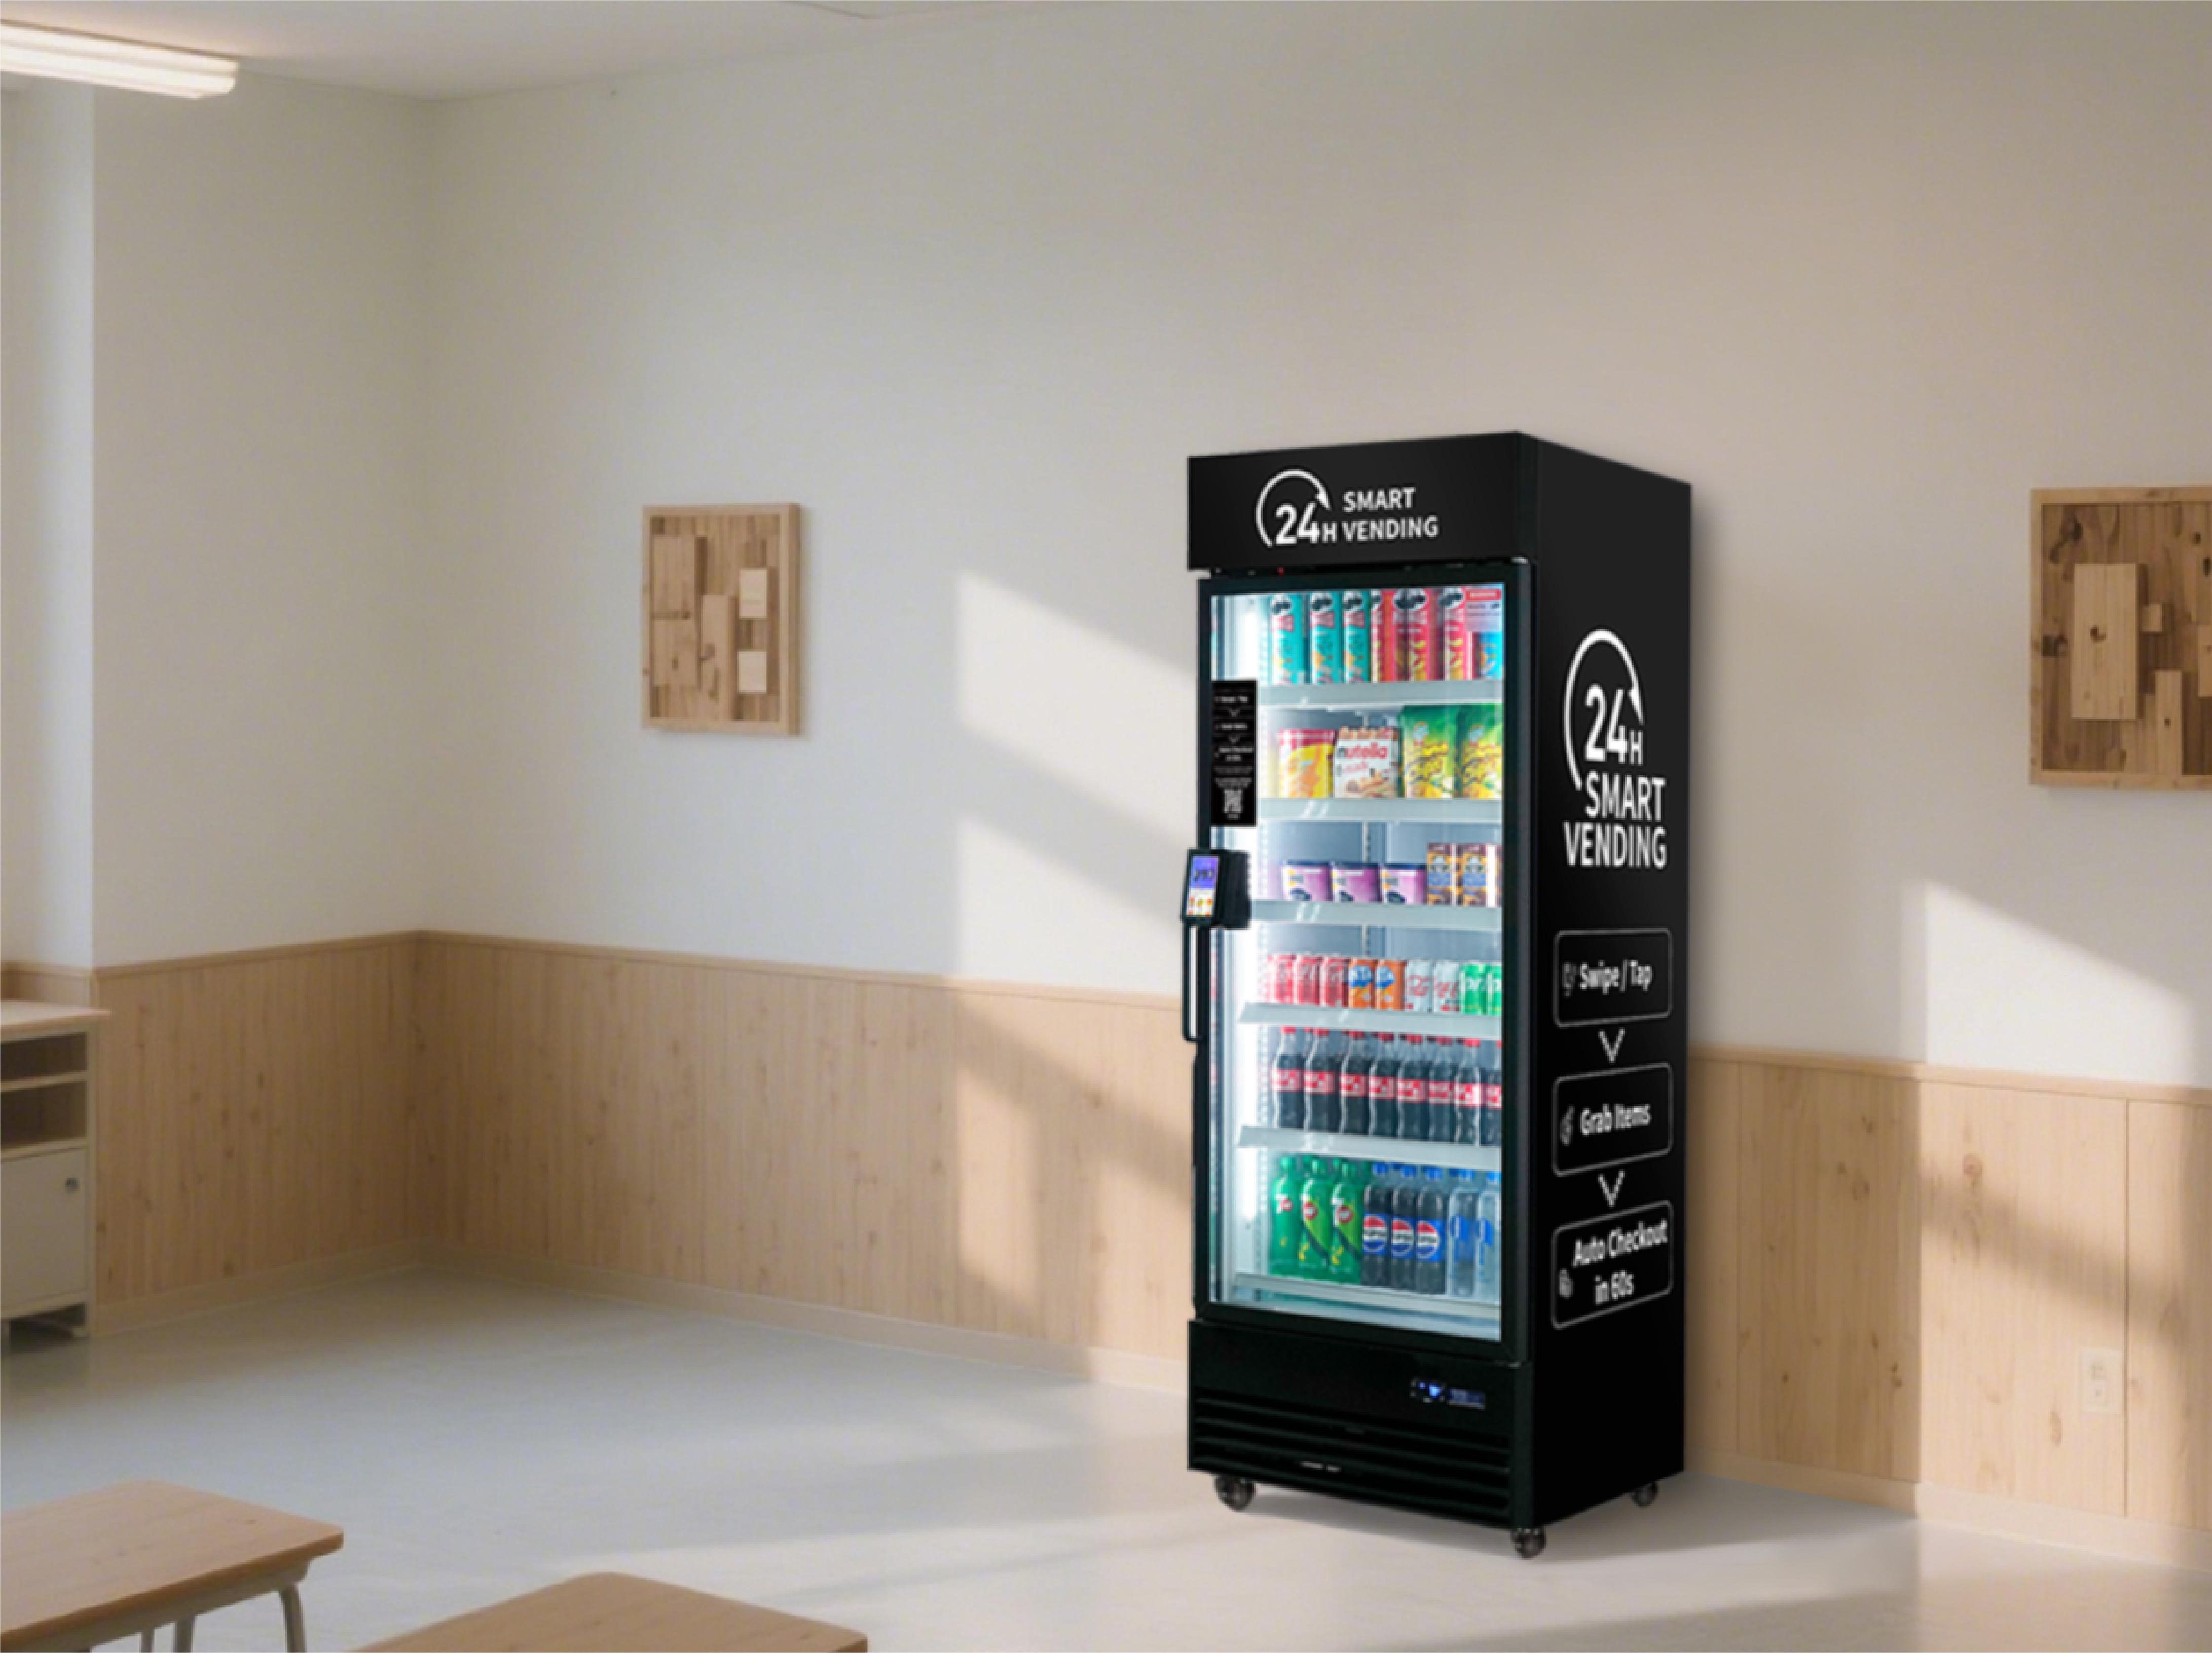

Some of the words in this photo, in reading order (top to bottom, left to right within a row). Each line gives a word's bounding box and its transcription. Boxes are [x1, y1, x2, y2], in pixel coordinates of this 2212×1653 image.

[1343, 486, 1417, 512] SMART
[1342, 515, 1439, 541] VENDING
[1586, 771, 1667, 820] SMART
[1563, 821, 1667, 869] VENDING
[1579, 960, 1619, 995] Swipe
[1629, 960, 1652, 992] Tap
[1580, 1103, 1613, 1136] Grab
[1614, 1103, 1651, 1130] Items
[1572, 1234, 1606, 1267] Auto
[1607, 1218, 1668, 1258] Checkout
[1594, 1275, 1609, 1305] in
[1611, 1270, 1634, 1300] 60s
